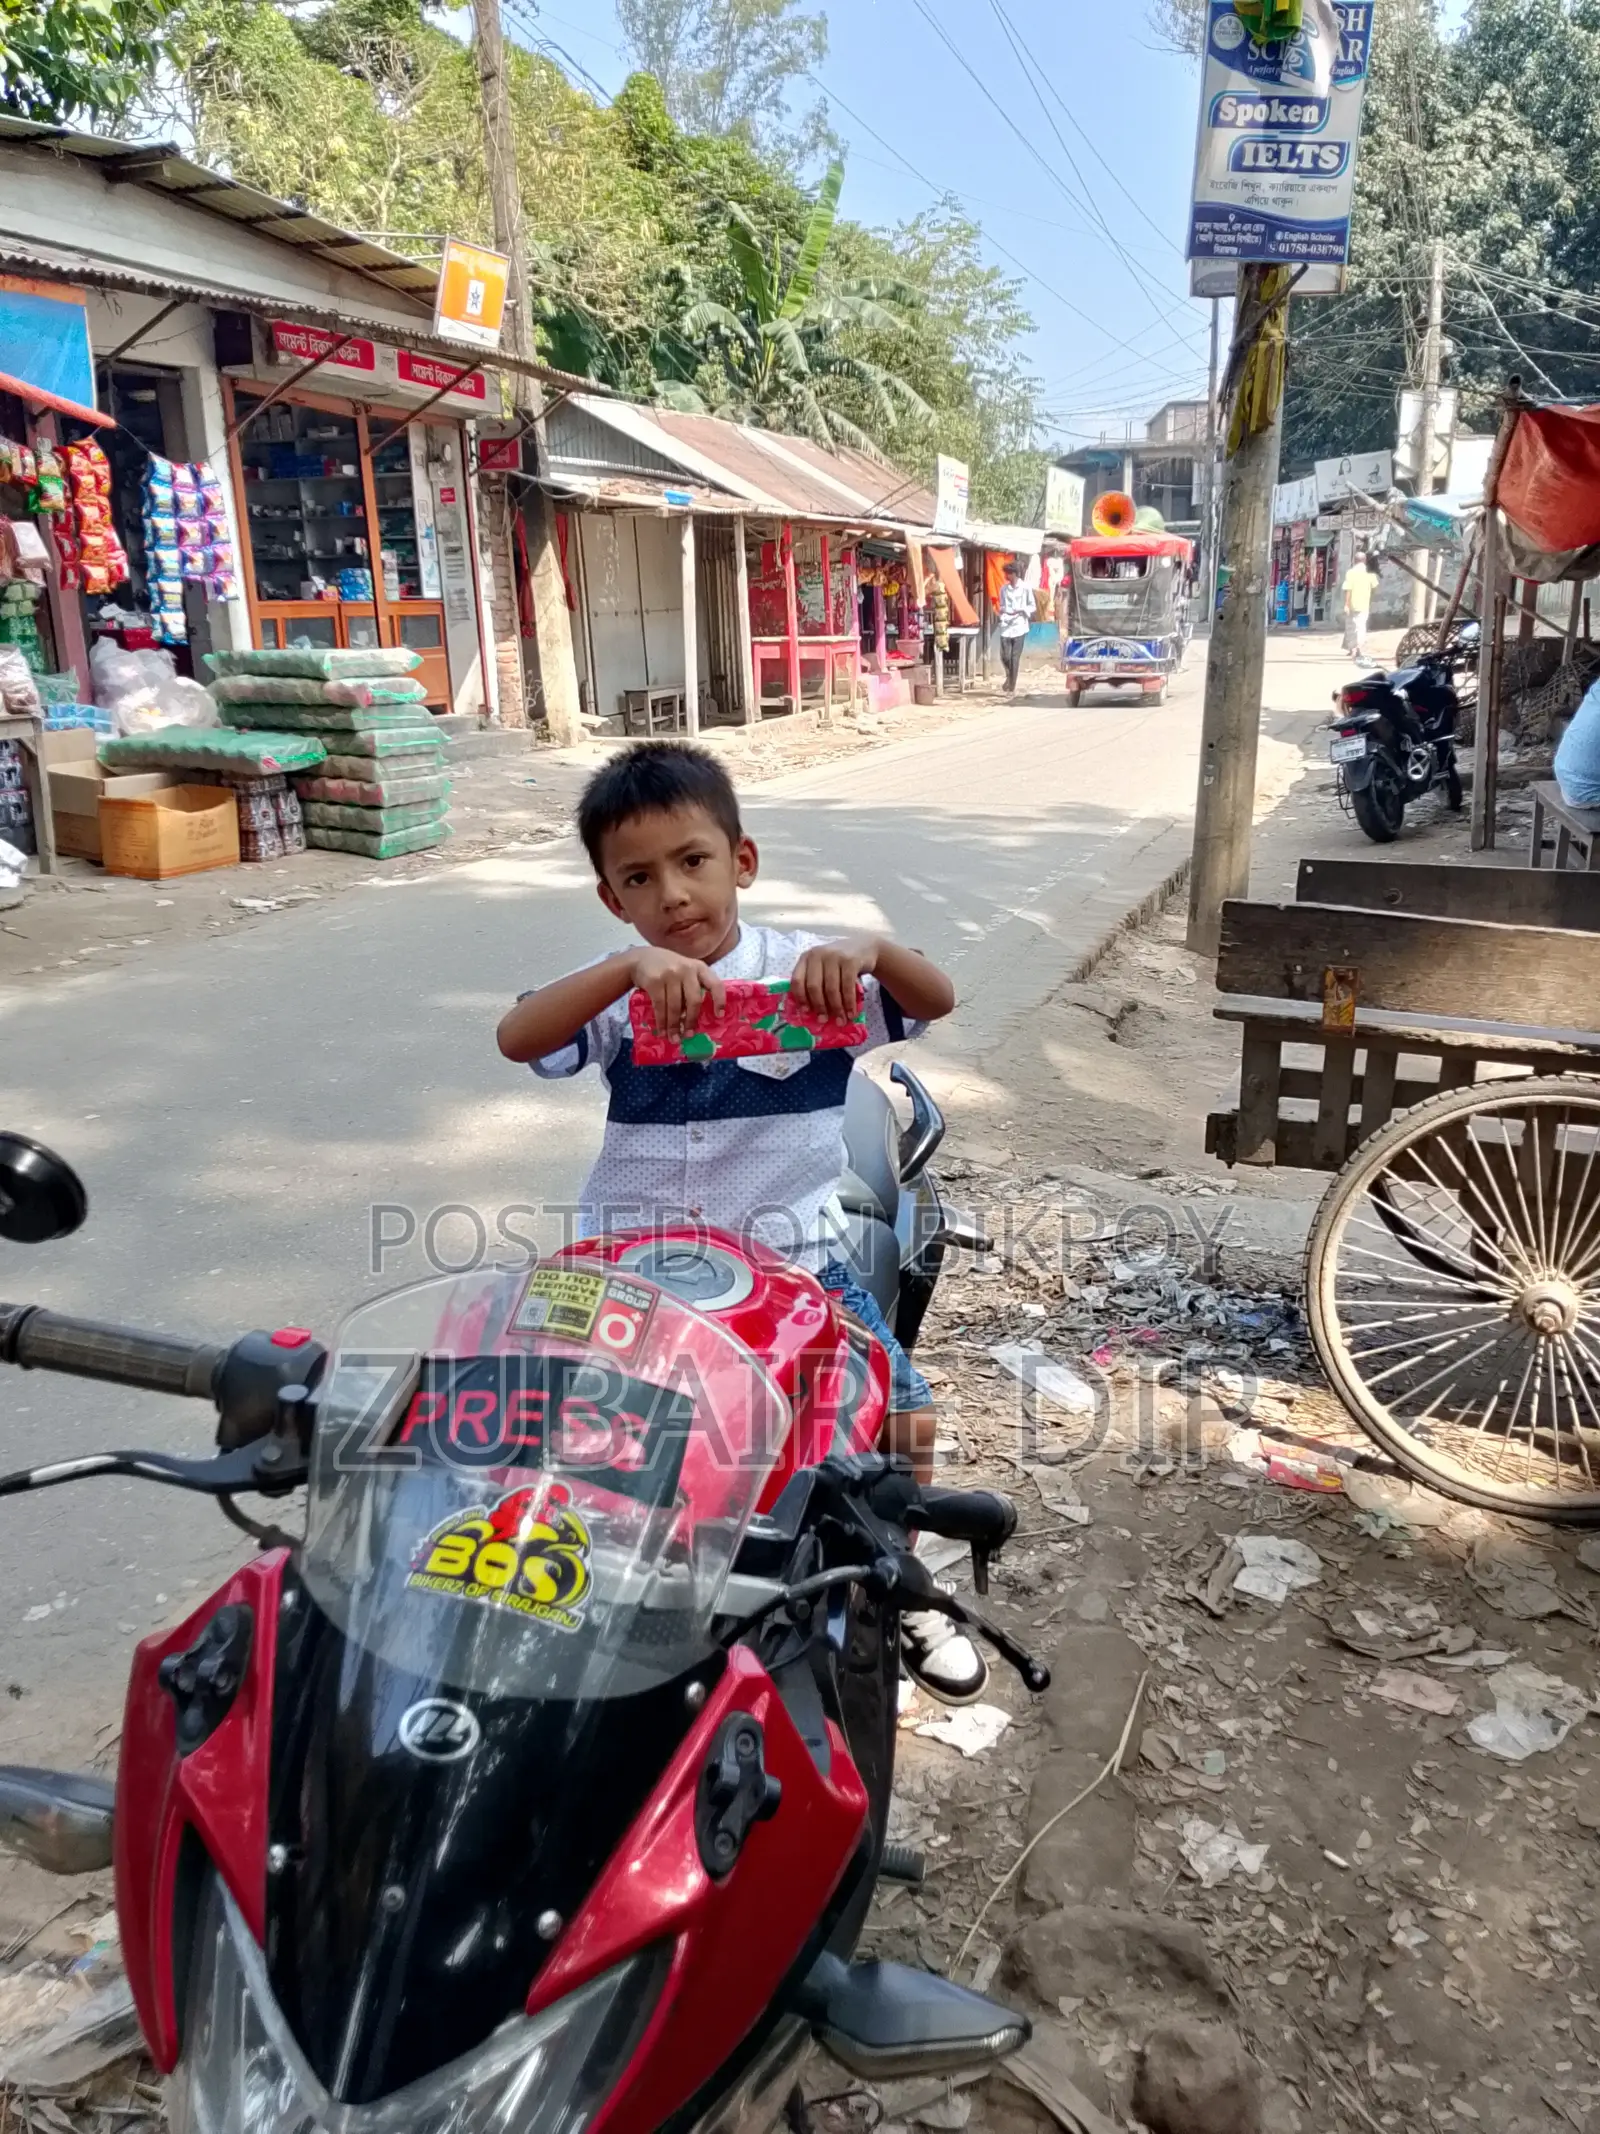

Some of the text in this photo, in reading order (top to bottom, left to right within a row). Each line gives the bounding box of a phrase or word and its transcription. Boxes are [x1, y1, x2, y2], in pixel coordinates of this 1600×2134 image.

[1219, 98, 1320, 128] Spoken
[1241, 143, 1341, 170] IELTS
[1284, 232, 1309, 242] English
[608, 1287, 650, 1310] GROUP
[400, 1389, 648, 1473] PRESS
[409, 1573, 464, 1593] BIKERZ
[464, 1583, 491, 1597] OF
